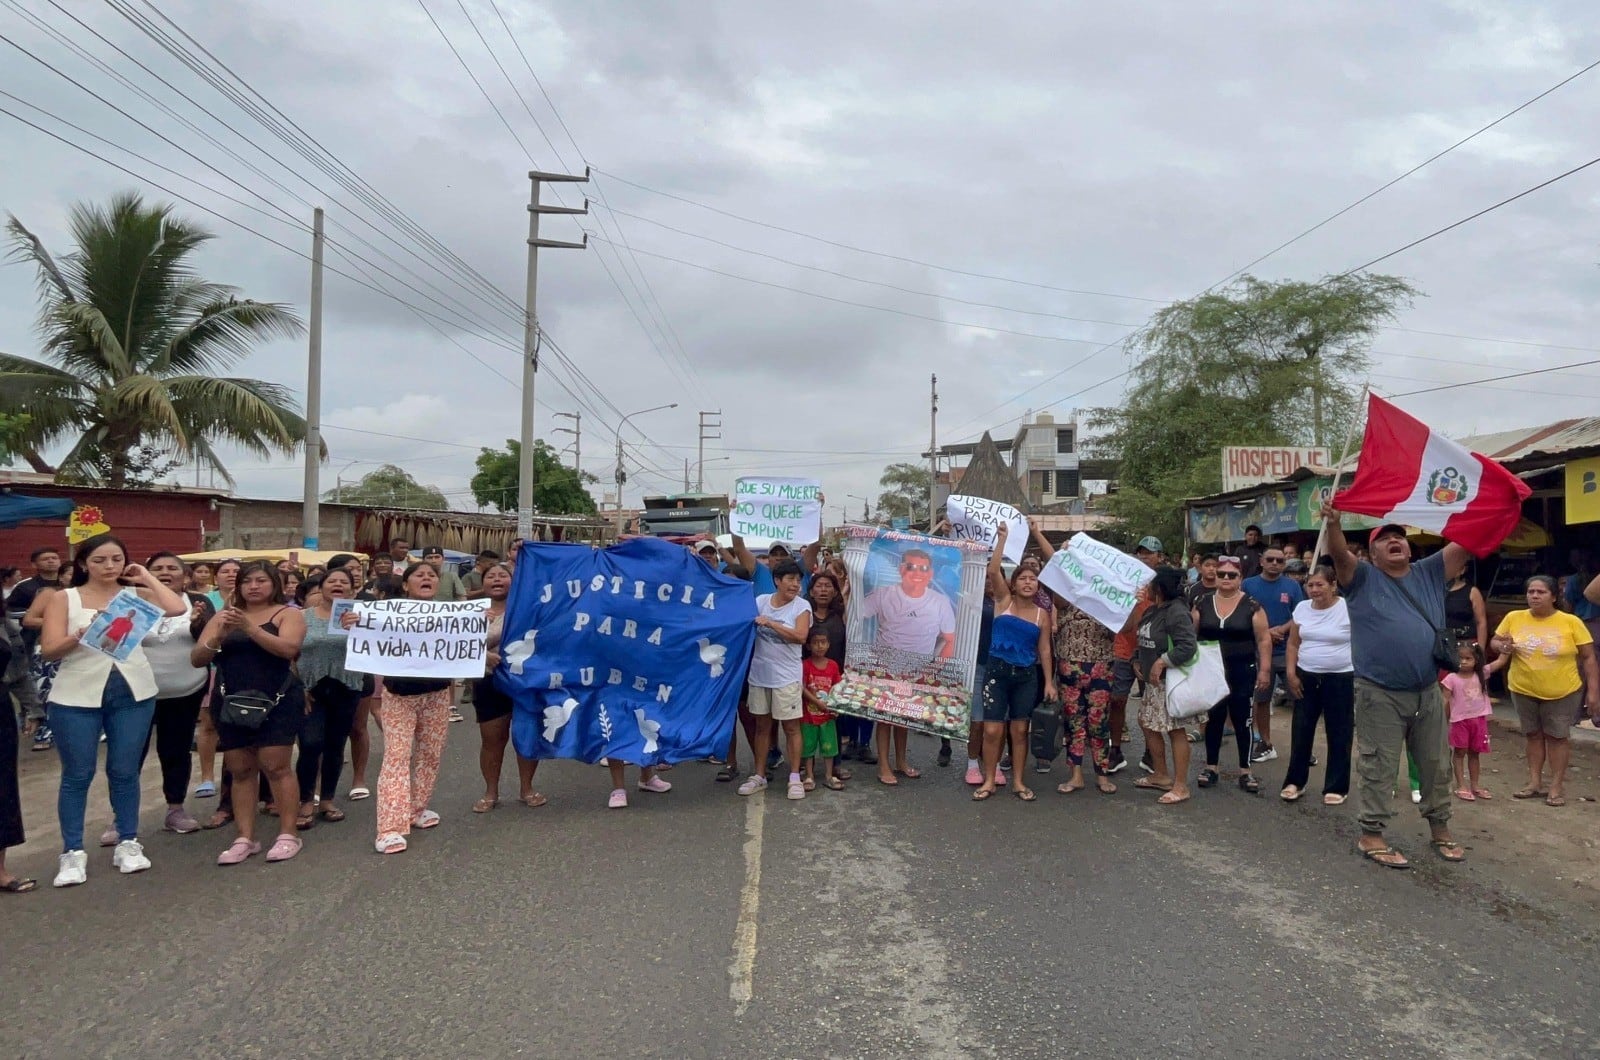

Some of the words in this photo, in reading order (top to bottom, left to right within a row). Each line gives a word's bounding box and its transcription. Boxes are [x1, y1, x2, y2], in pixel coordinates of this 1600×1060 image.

[735, 480, 758, 495] QUE
[760, 482, 775, 494] SU
[778, 484, 820, 499] MUERTE
[736, 502, 755, 515] NO
[964, 506, 999, 530] PARA
[737, 520, 793, 540] IMPUNE
[1058, 552, 1084, 581] PARA
[1090, 573, 1135, 608] RUBEN
[540, 574, 715, 610] JUSTICIA
[356, 611, 377, 630] LE
[381, 615, 488, 634] ARREBATARON
[573, 612, 663, 645] PARA
[352, 637, 371, 656] LA
[418, 641, 429, 658] A
[549, 667, 673, 703] RUBEN
